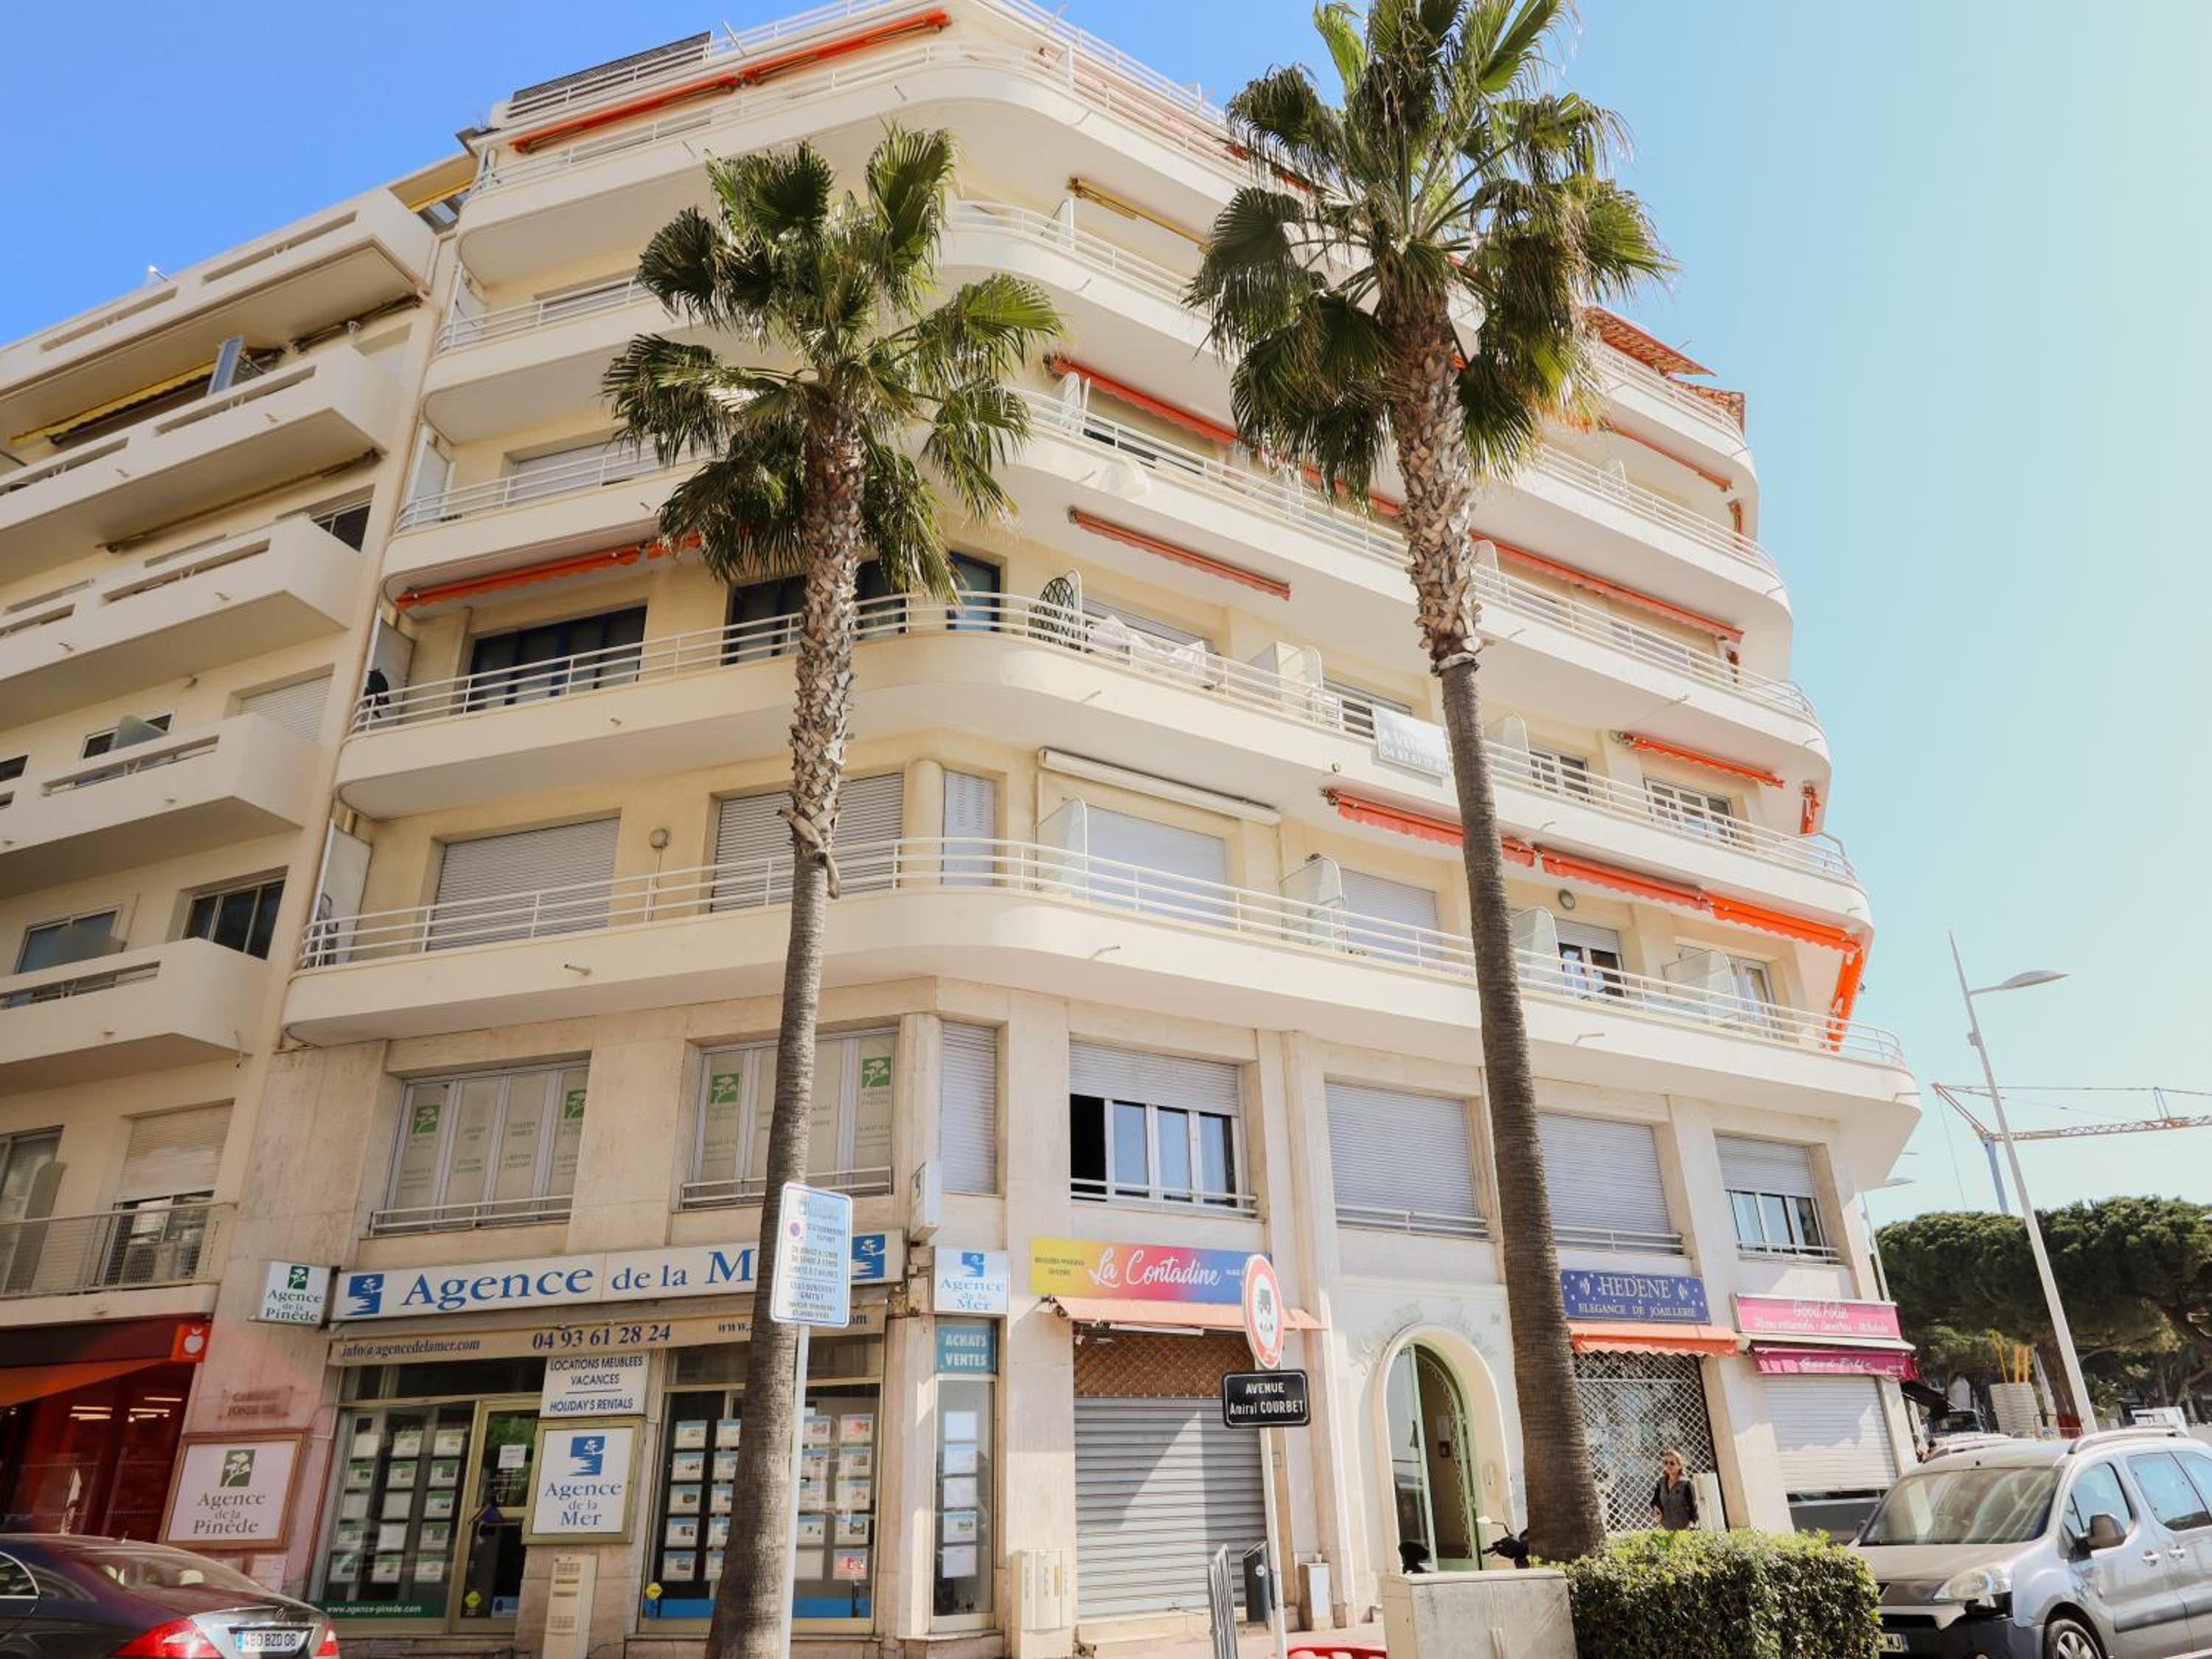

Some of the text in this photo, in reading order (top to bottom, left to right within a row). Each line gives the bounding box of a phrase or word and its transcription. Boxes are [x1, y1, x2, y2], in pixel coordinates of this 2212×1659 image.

[1089, 1248, 1222, 1288] La Contadine
[402, 1268, 593, 1310] Agence
[611, 1267, 650, 1290] de
[661, 1265, 687, 1287] la
[941, 1279, 1004, 1291] Agence
[268, 1289, 322, 1303] Agence
[532, 1324, 672, 1351] 04 93 61 28 24
[945, 1334, 987, 1347] ACHATS
[341, 1338, 481, 1358] info@agencedelamer.com
[550, 1358, 600, 1371] LOCATIONS
[945, 1352, 987, 1366] VENTES
[570, 1374, 620, 1386] VACANCES
[1245, 1382, 1285, 1394] AVENUE
[597, 1397, 633, 1411] RENTALS
[1230, 1400, 1304, 1415] Amiral COURBET
[545, 1481, 622, 1500] Agence
[198, 1492, 266, 1510] Agence
[568, 1499, 598, 1511] de la
[215, 1509, 240, 1519] de la
[560, 1511, 602, 1526] Mer
